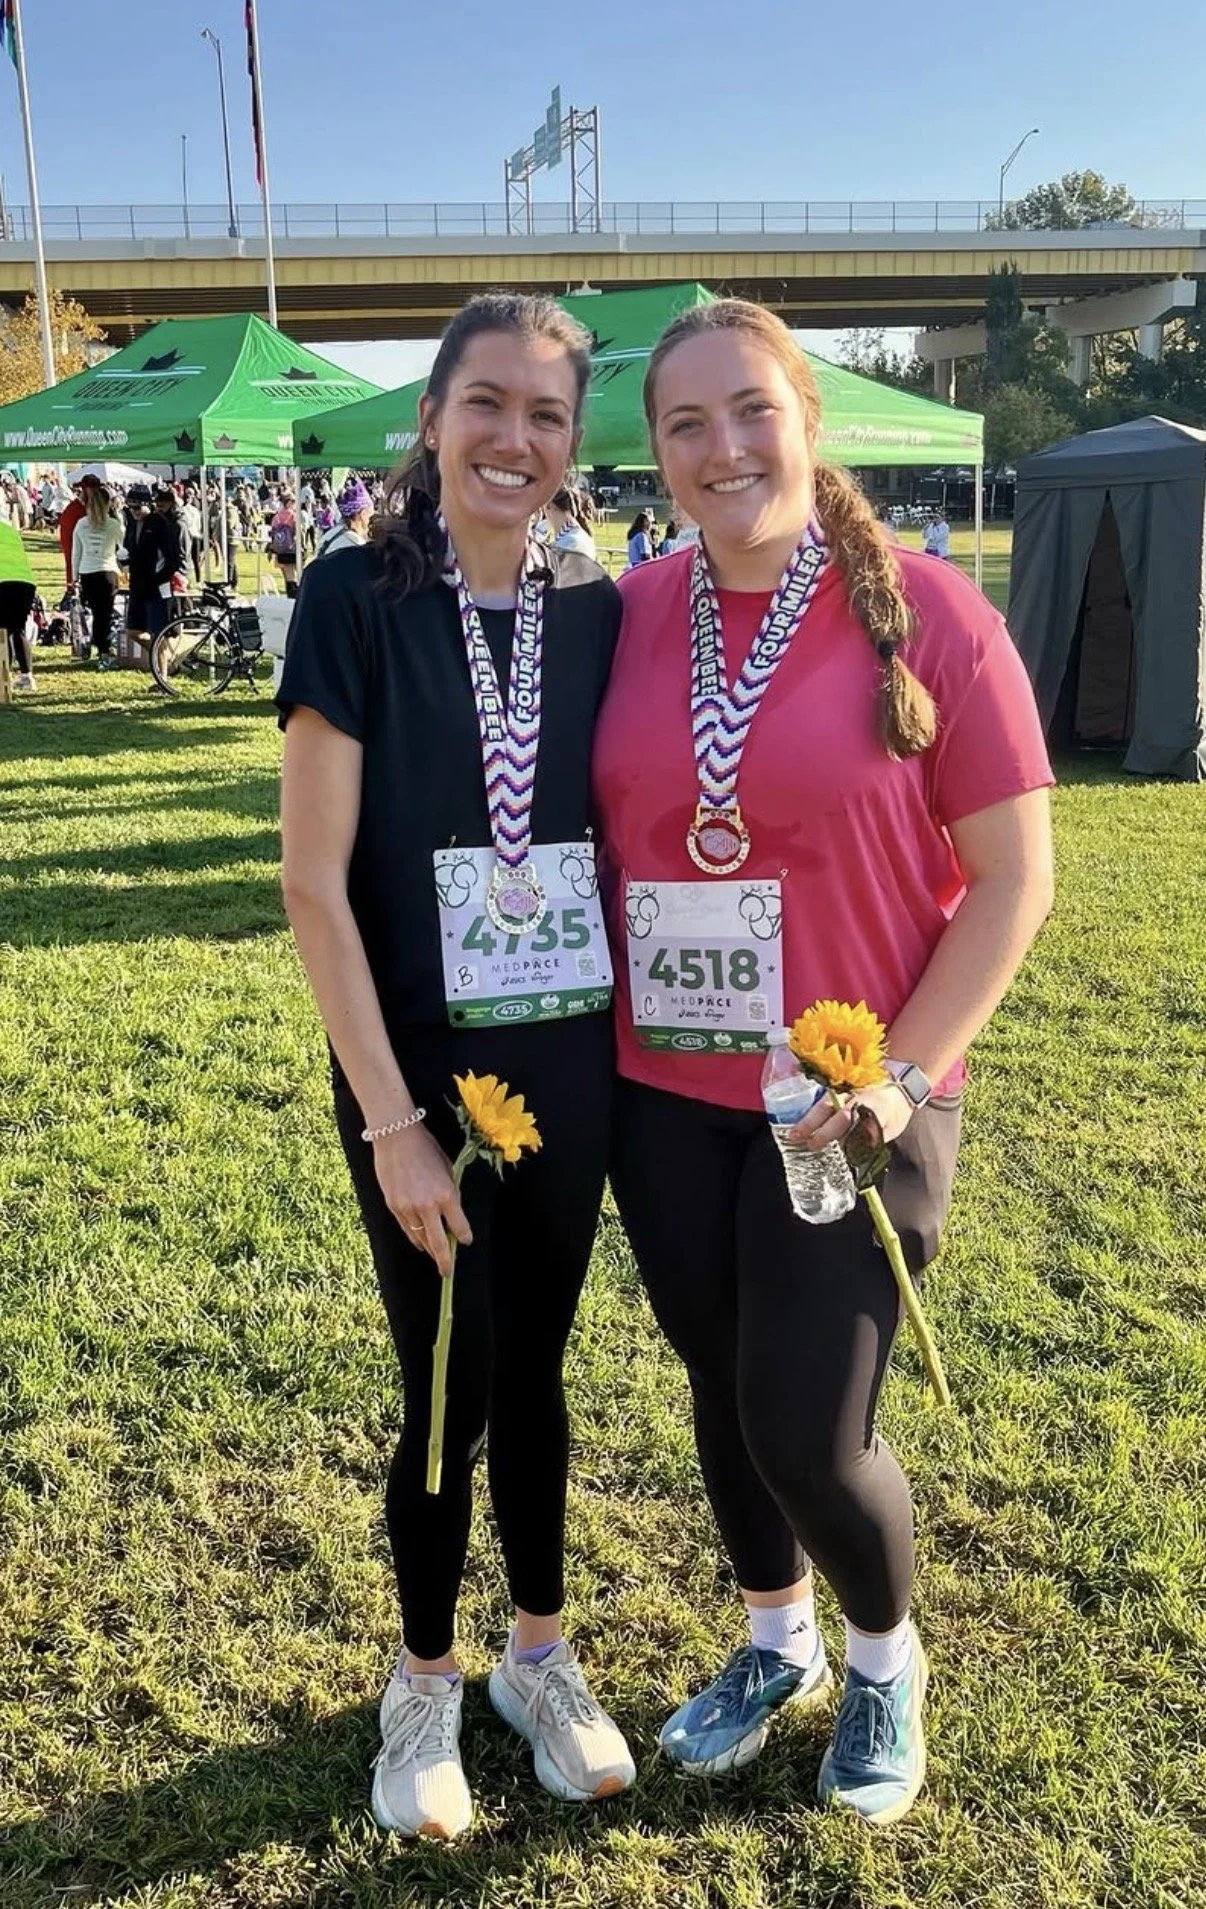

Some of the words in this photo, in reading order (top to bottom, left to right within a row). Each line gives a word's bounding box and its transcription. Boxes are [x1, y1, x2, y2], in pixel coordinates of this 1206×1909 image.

[71, 379, 142, 398] QUEEN
[130, 377, 187, 397] CITY
[259, 385, 322, 398] QUEEN
[325, 385, 366, 399] CITY
[4, 425, 128, 451] www.QueenCityRunning.com
[520, 582, 538, 654] MILER
[752, 611, 795, 668] FOUR
[778, 547, 823, 612] MILER
[696, 595, 717, 661] QUEEN
[468, 610, 495, 692] QUEEN
[482, 696, 503, 742] BEE
[516, 656, 534, 722] FOUR
[700, 661, 719, 696] BEE
[461, 908, 591, 956] 4735
[458, 965, 474, 987] B
[491, 957, 560, 973] MEDPACE
[648, 948, 760, 991] 4518
[499, 1003, 529, 1016] 4735
[644, 995, 657, 1016] C
[670, 995, 732, 1007] MEDPACE
[679, 1036, 704, 1047] 4518
